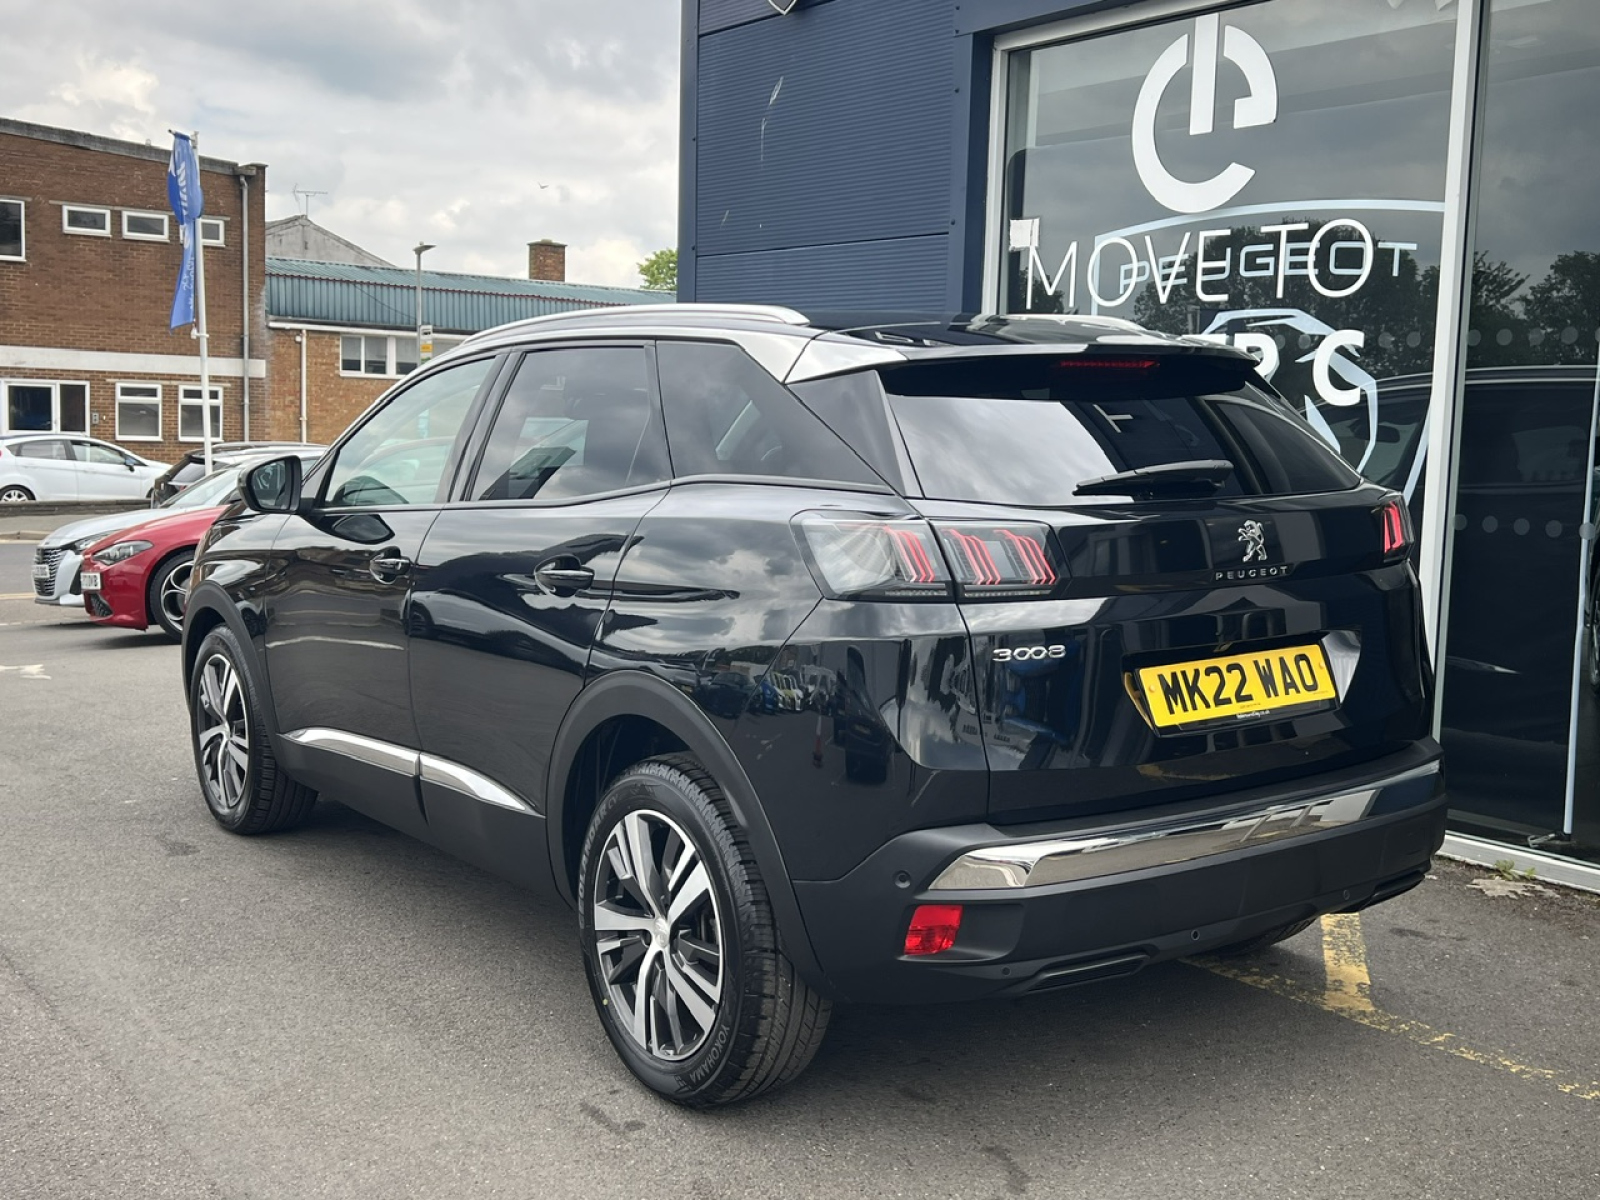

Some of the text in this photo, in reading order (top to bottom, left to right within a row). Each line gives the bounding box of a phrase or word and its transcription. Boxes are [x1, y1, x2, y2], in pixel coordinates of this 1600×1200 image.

[1026, 218, 1374, 310] MOVE TO
[1119, 240, 1418, 294] PEUGEOT
[1215, 565, 1288, 581] PEUGEOT
[992, 644, 1067, 662] 3008
[1157, 653, 1319, 715] MK22 WAO
[689, 1023, 731, 1084] YOKOHAMA
